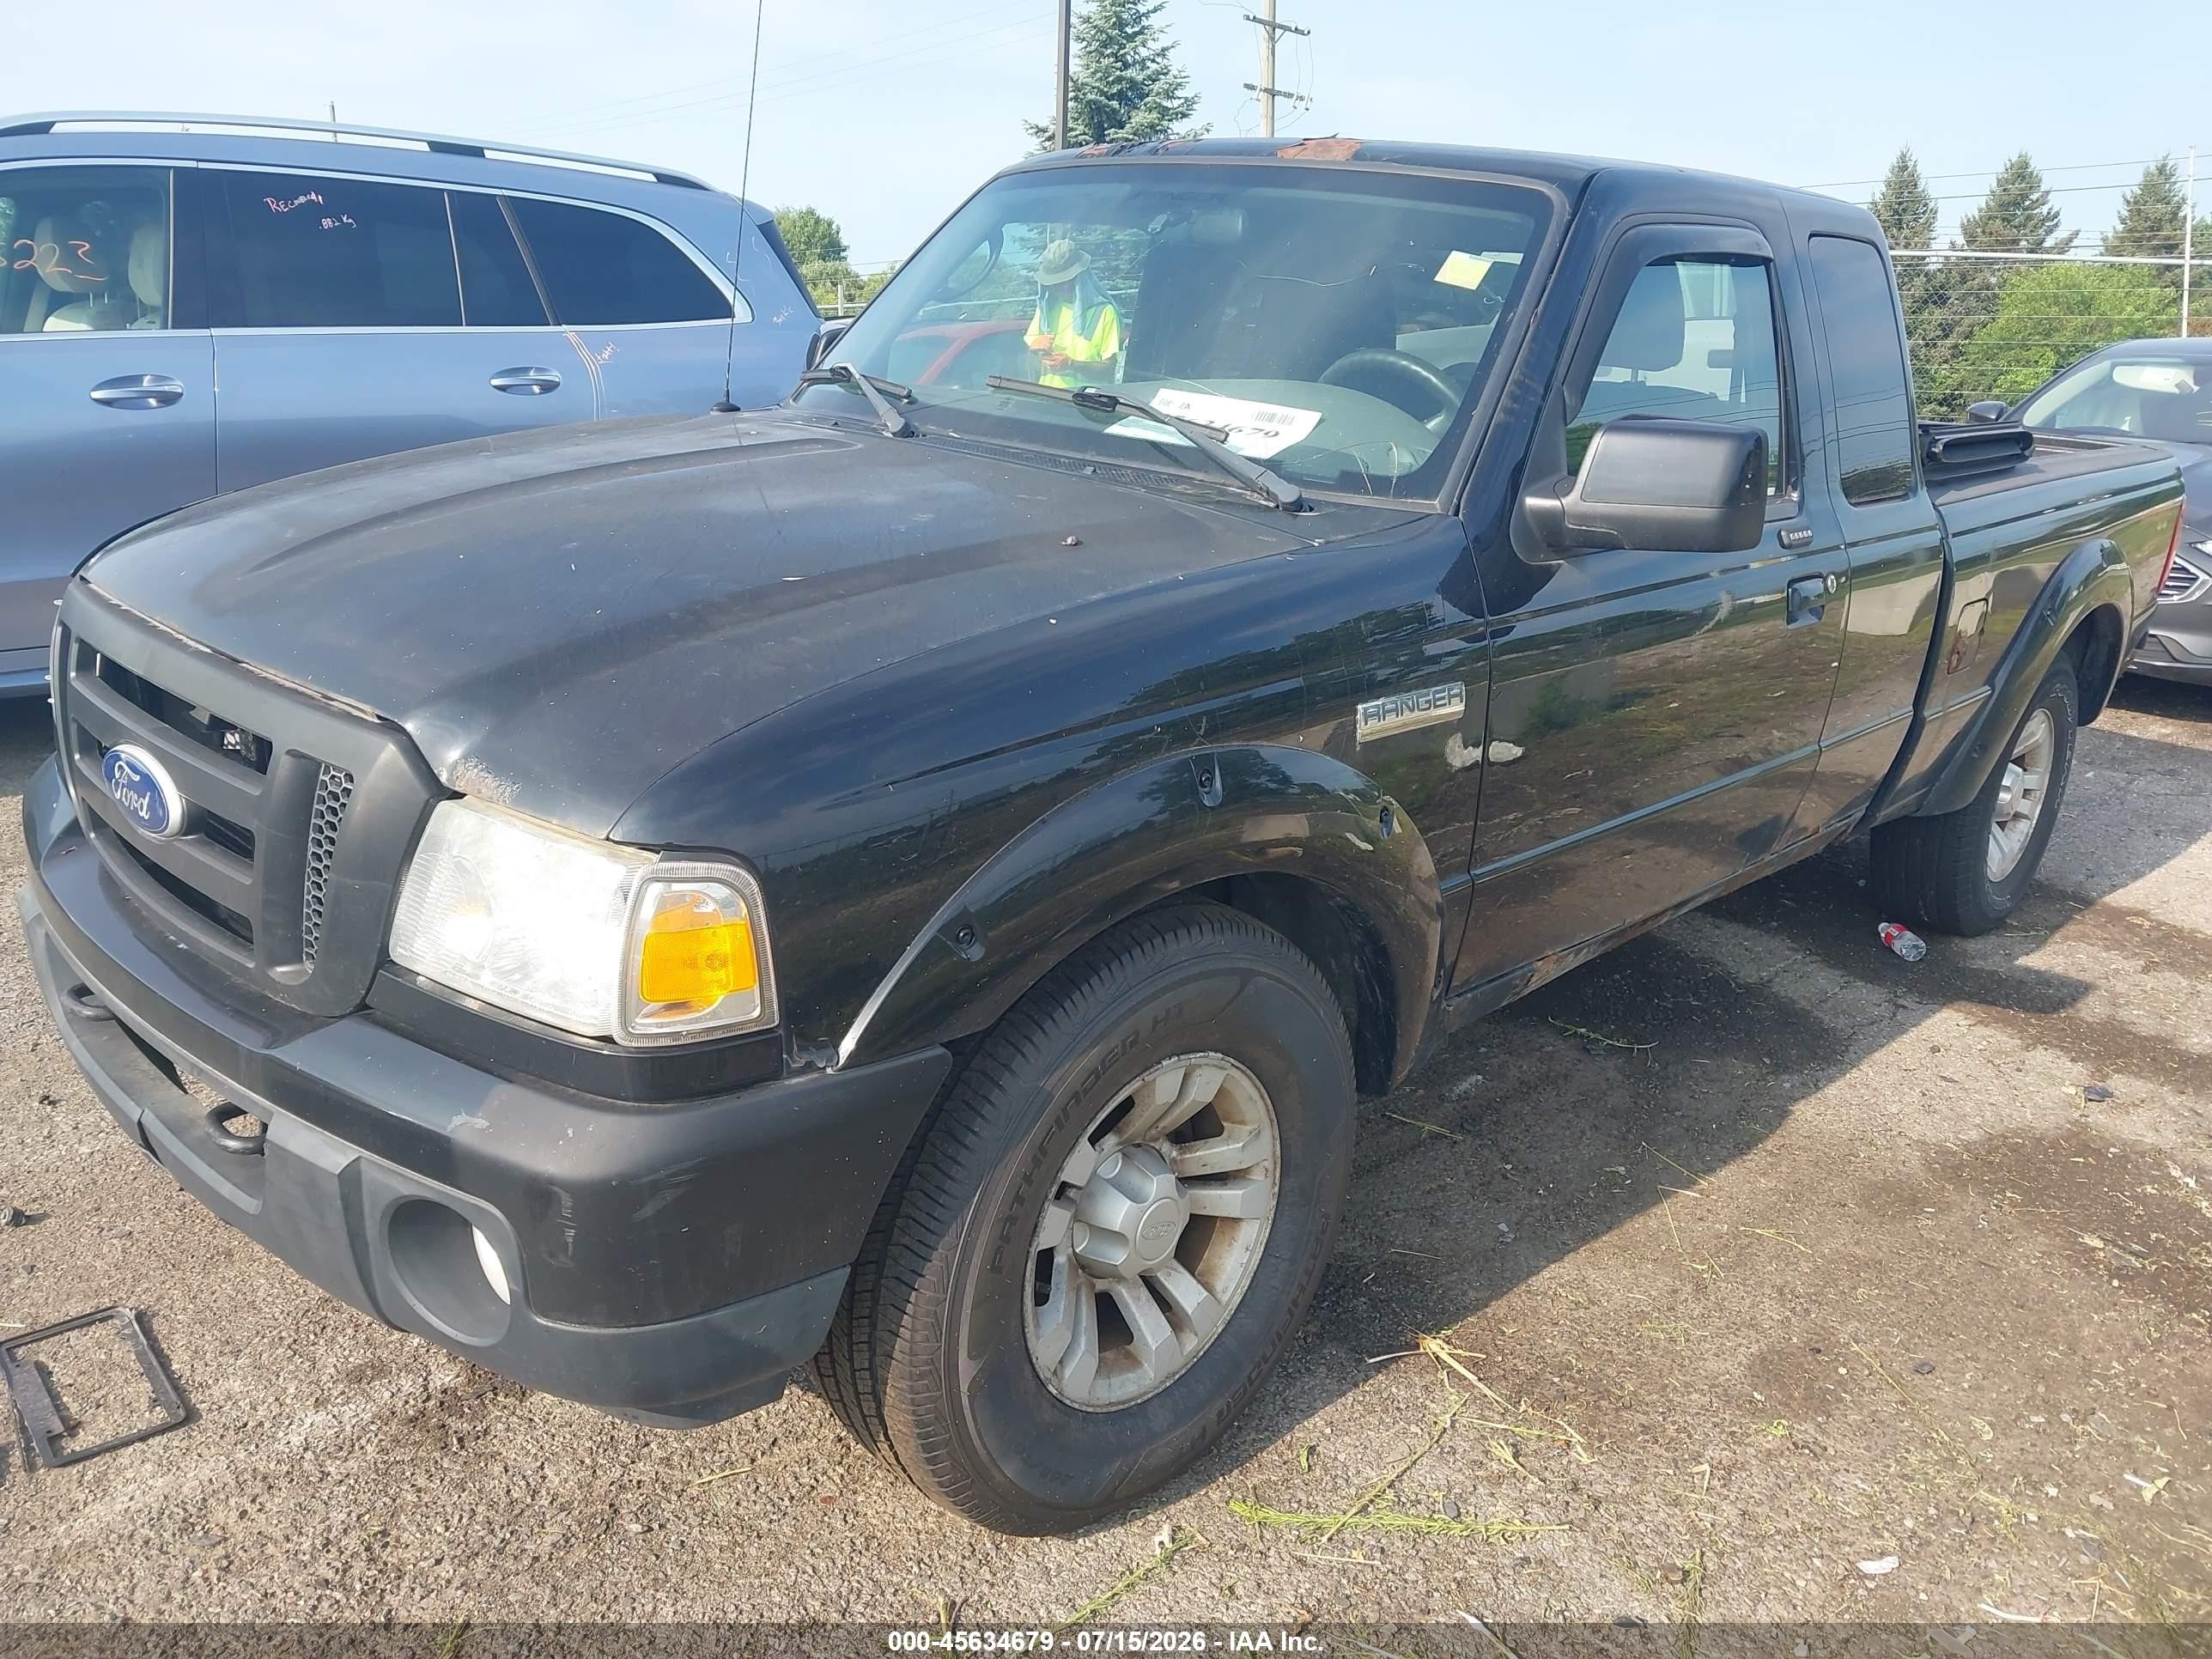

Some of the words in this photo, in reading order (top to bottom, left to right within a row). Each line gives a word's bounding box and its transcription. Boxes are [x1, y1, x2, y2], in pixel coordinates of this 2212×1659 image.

[1362, 686, 1464, 726] RANGER
[112, 760, 151, 820] Ford
[988, 1027, 1141, 1276] PATHFINDER
